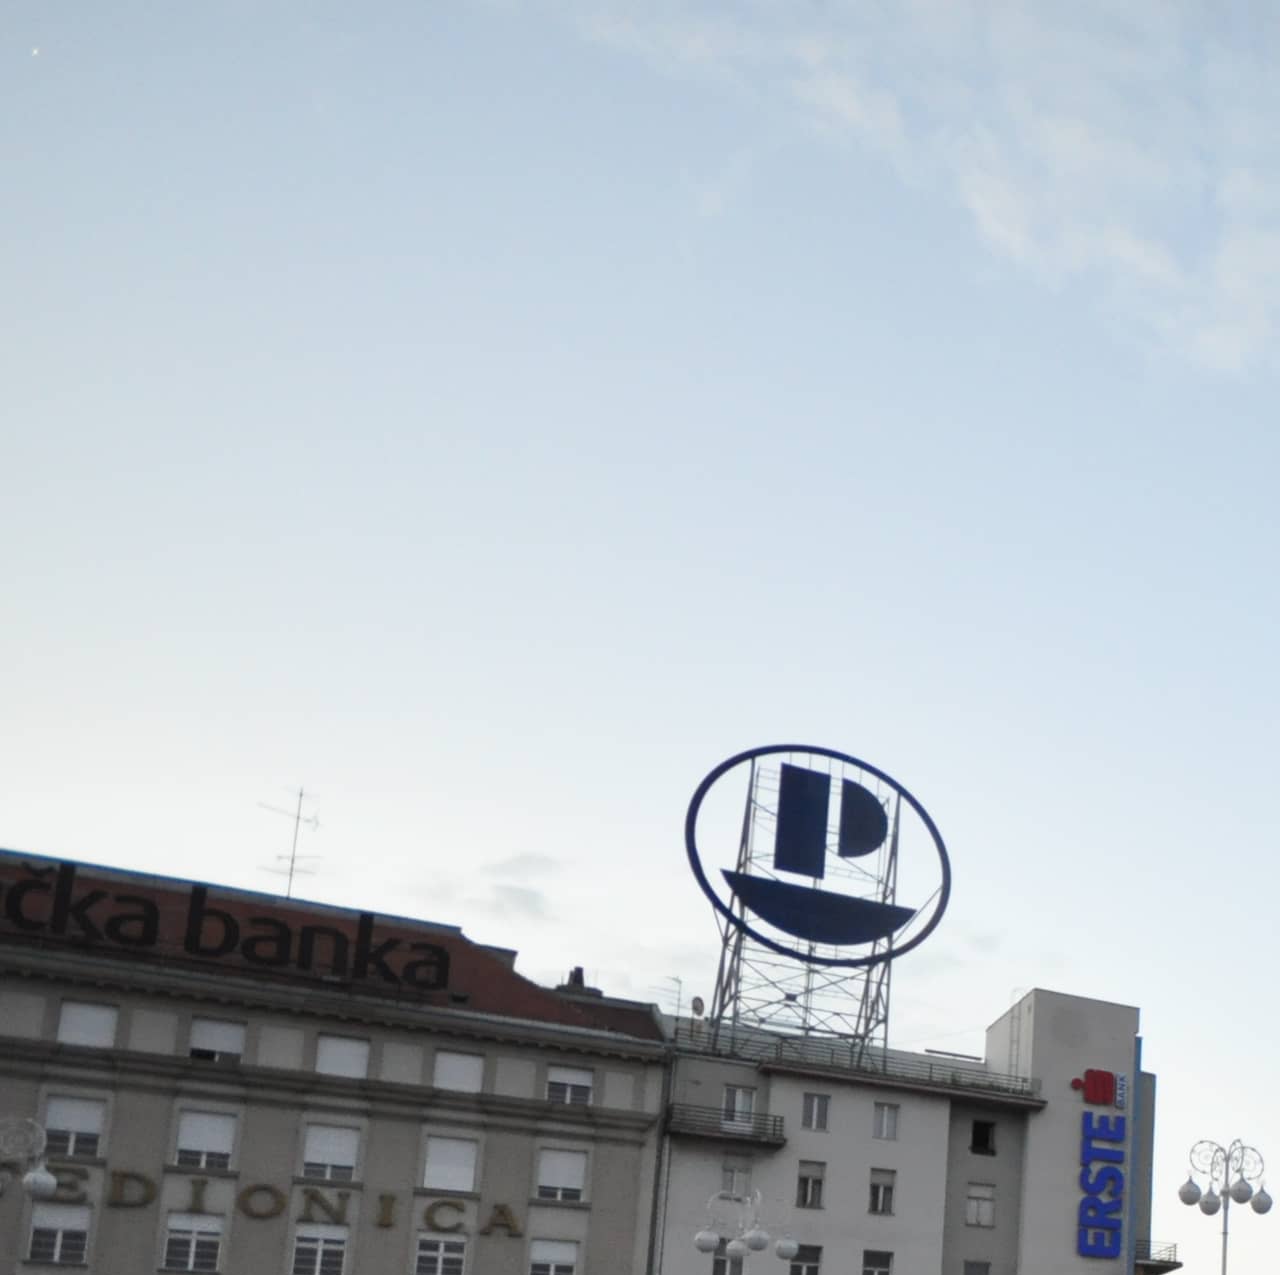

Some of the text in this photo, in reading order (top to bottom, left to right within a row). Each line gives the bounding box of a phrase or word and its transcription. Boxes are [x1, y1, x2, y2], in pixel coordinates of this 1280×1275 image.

[0, 862, 450, 991] čka banka
[1116, 1075, 1127, 1109] BANK
[1077, 1111, 1127, 1259] ERSTE
